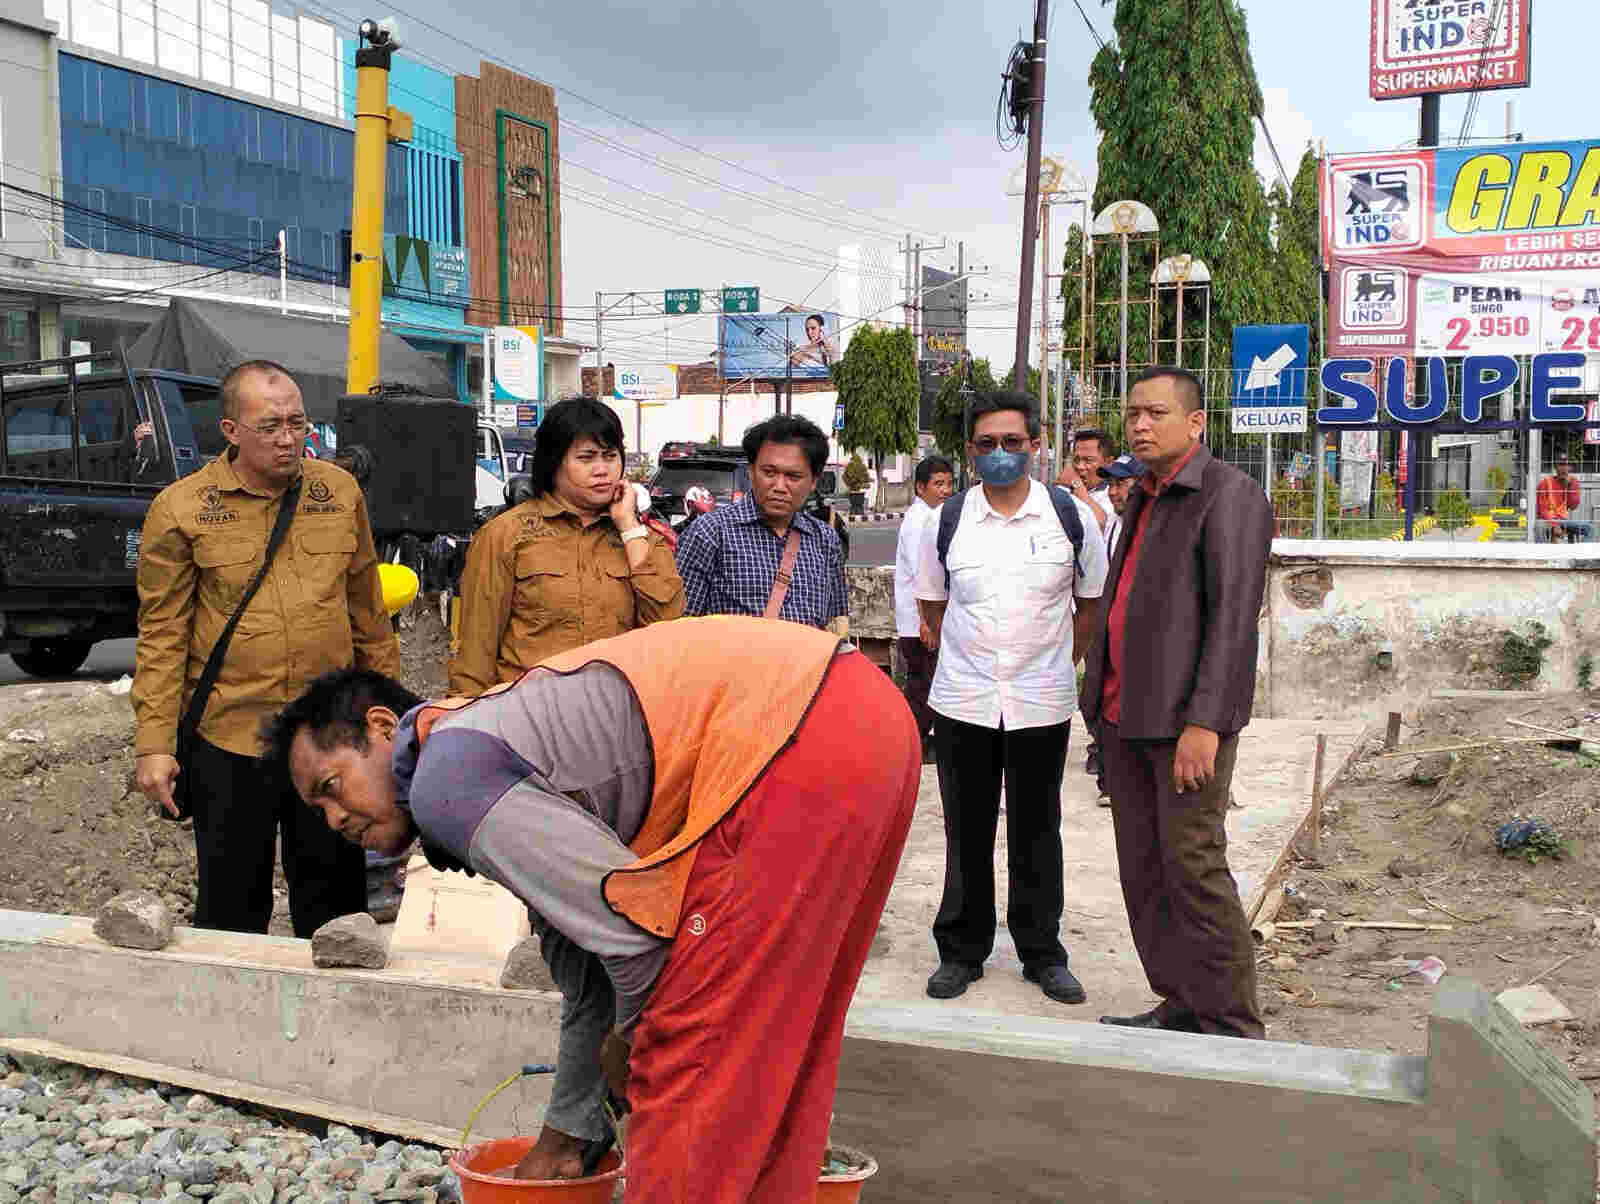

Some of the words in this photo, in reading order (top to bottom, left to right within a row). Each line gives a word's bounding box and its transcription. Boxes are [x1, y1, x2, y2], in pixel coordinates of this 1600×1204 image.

[1412, 2, 1486, 23] SUPER
[1376, 60, 1518, 93] SUPERMARKET
[1352, 213, 1402, 226] SUPER
[1504, 231, 1565, 251] LEBIH
[1479, 252, 1558, 270] RIBUAN
[1452, 286, 1522, 303] PEAR
[620, 373, 641, 386] BSI
[1316, 352, 1587, 424] SUPE
[1235, 412, 1303, 428] KELUAR
